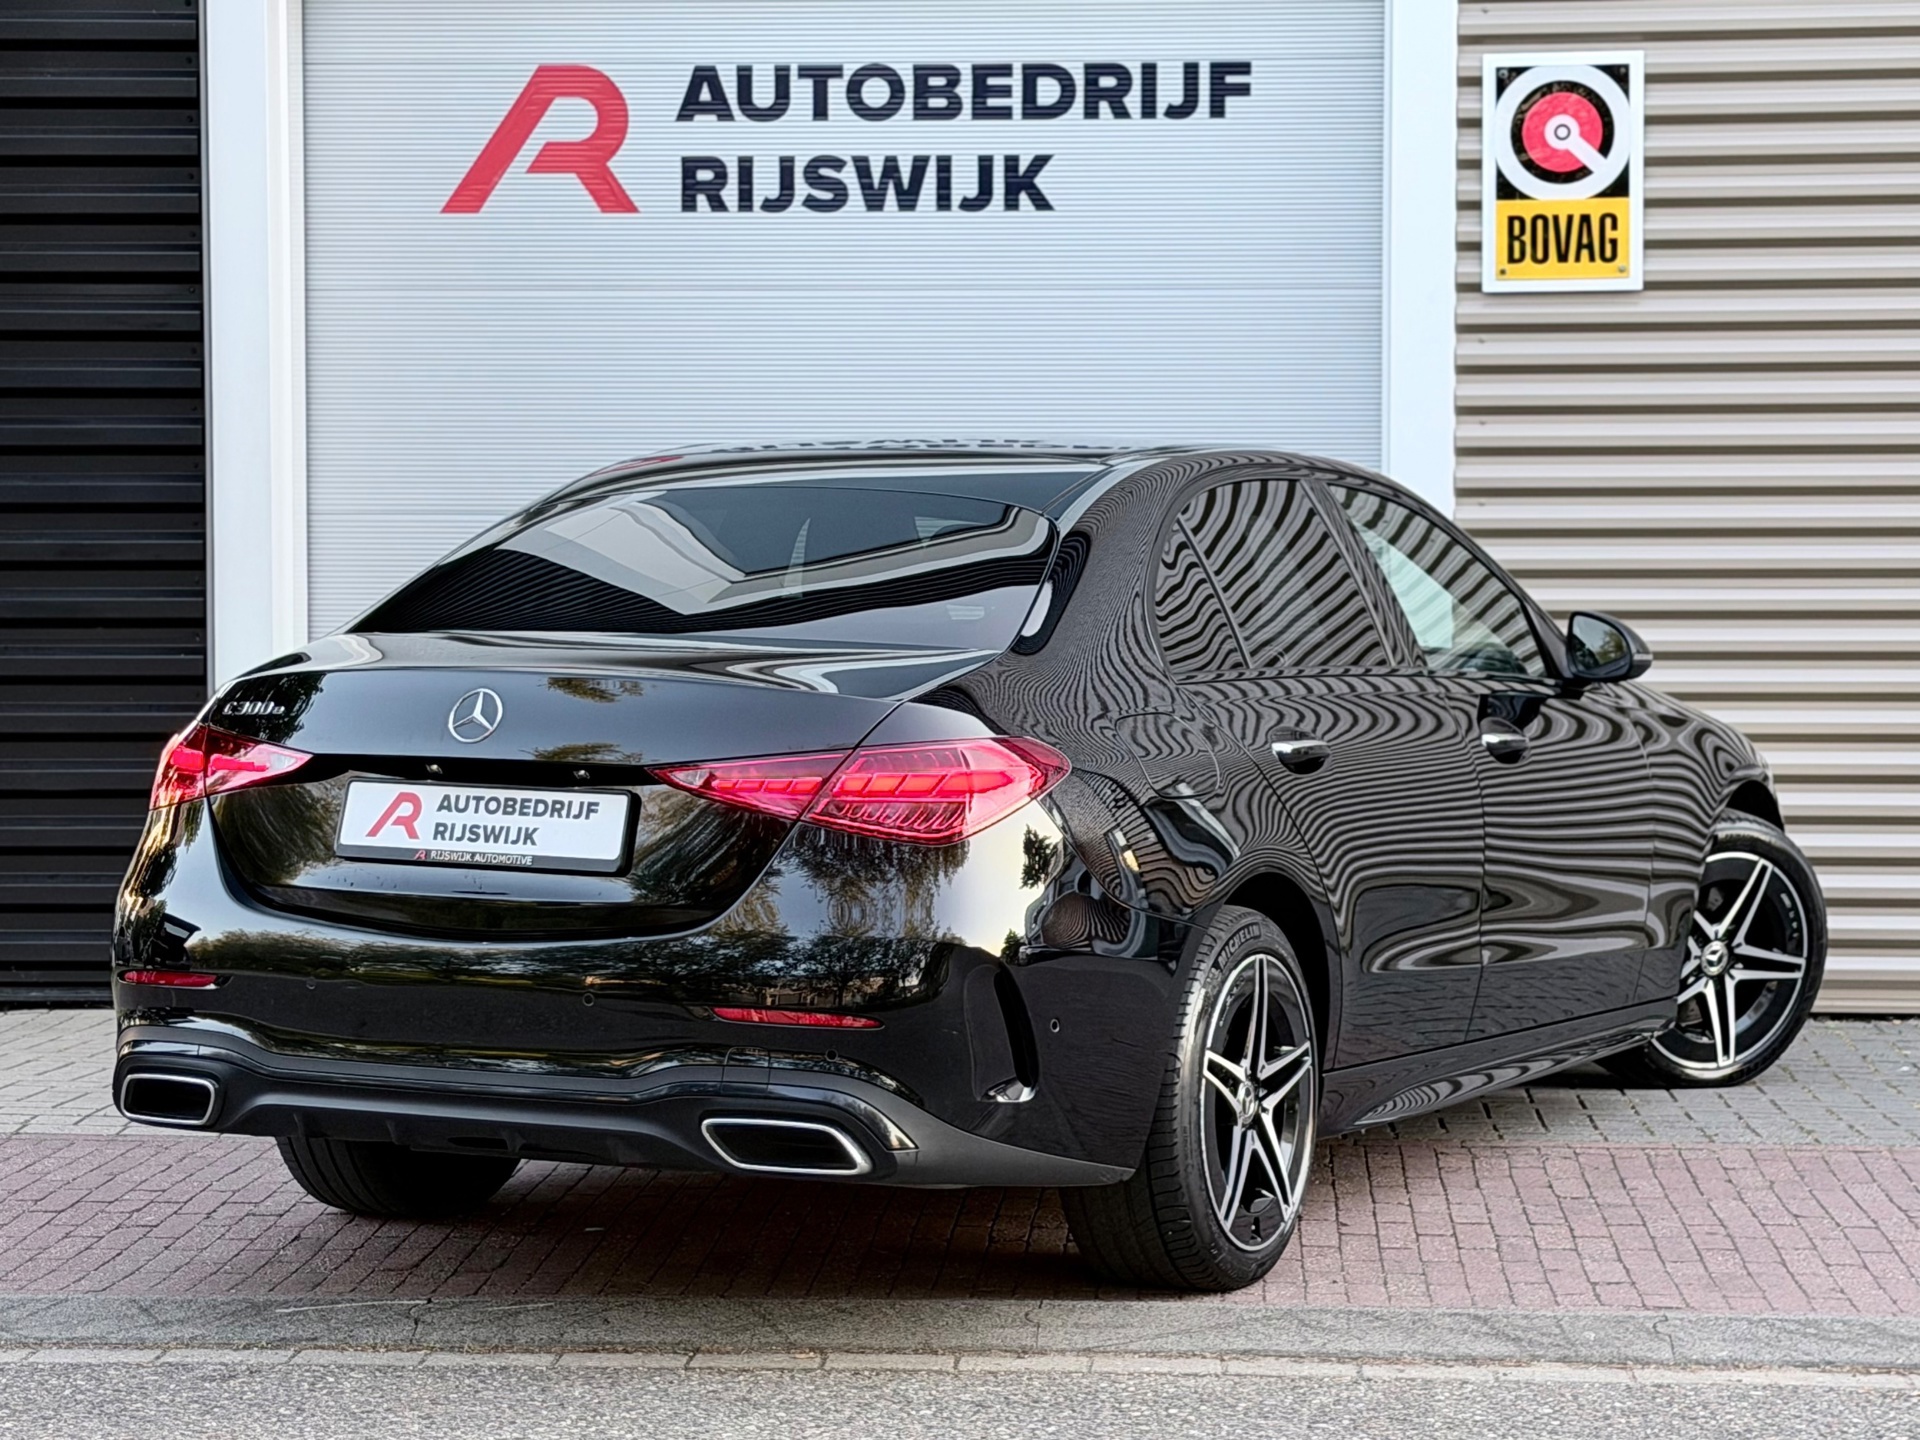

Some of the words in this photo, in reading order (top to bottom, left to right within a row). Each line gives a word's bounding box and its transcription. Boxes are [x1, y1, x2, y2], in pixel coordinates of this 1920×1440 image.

[676, 61, 1252, 122] AUTOBEDRIJF
[681, 154, 1054, 213] RIJSWIJK
[1507, 212, 1618, 265] BOVAG
[436, 794, 600, 820] AUTOBEDRIJF
[432, 822, 540, 846] RIJSWIJK
[430, 850, 473, 862] RIJSWIJK
[474, 854, 533, 865] AUTOMOTIVE
[1217, 924, 1261, 969] MICHELIN
